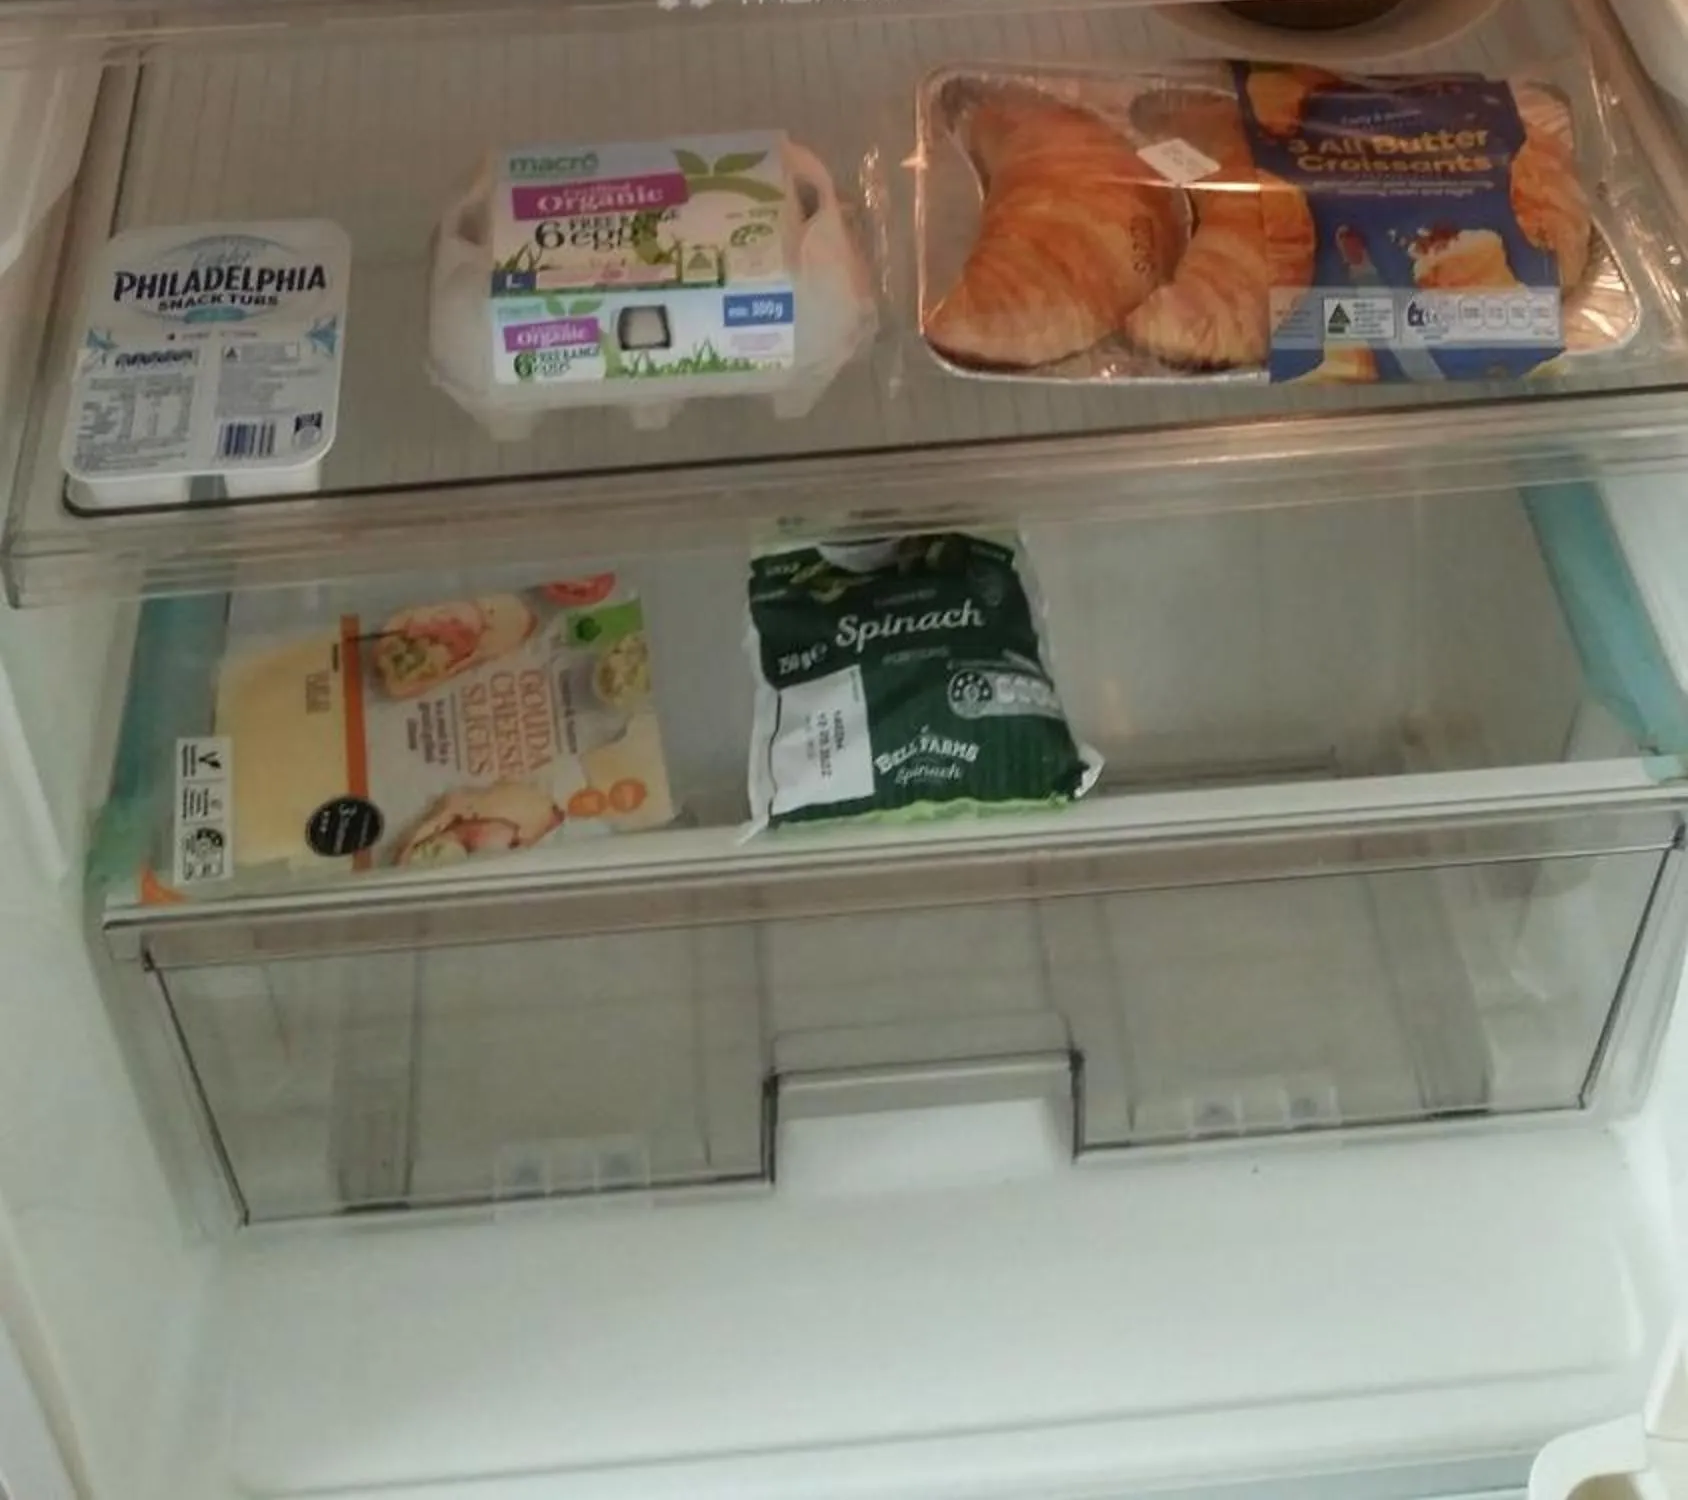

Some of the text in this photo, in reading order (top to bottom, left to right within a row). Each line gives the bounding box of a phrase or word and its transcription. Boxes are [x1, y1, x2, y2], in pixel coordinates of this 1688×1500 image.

[1288, 128, 1489, 155] 3 All Butter
[1297, 154, 1493, 173] Croissants
[536, 185, 665, 213] Organic
[534, 219, 566, 250] 6
[568, 214, 614, 231] FREE
[113, 263, 328, 303] PHILADELPHIA
[506, 273, 521, 289] L
[157, 292, 279, 313] SNACK TUBS
[513, 353, 533, 378] 6
[835, 598, 988, 653] Spinach
[462, 683, 494, 777] SLICES
[489, 670, 529, 783] CHEESE
[518, 668, 554, 769] GOUDA
[918, 735, 980, 763] FARMS
